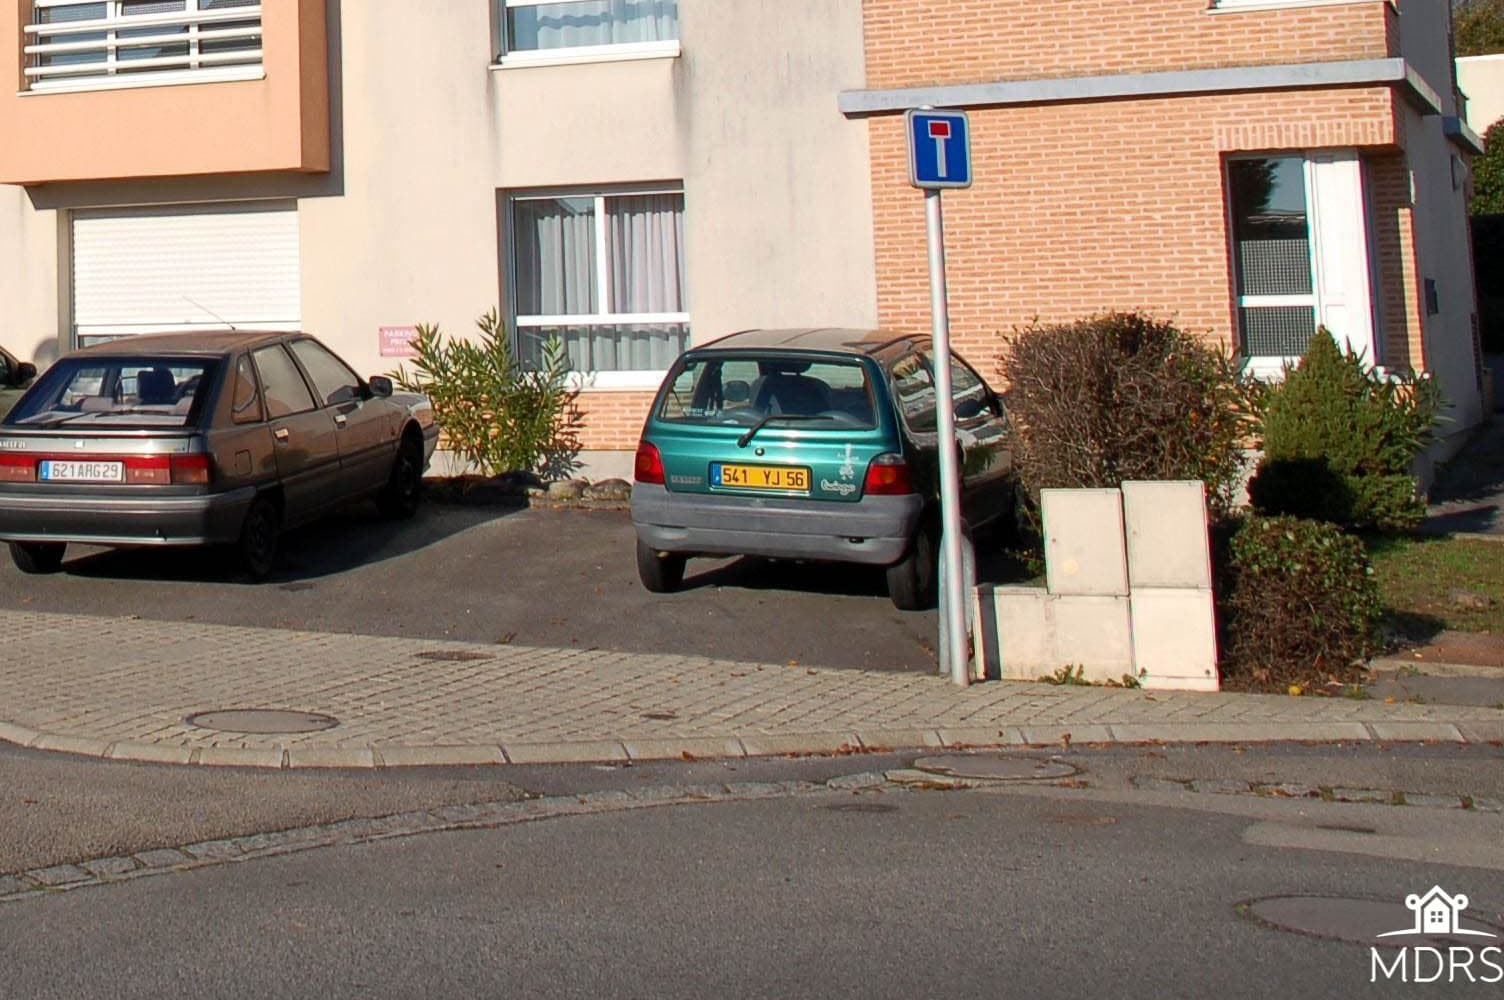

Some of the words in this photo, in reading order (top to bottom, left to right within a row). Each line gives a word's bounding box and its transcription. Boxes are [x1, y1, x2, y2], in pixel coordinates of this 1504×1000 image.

[52, 463, 75, 478] 621
[77, 463, 100, 478] ARG
[102, 464, 118, 479] 29
[723, 467, 749, 483] 541
[763, 469, 781, 486] YJ
[787, 471, 804, 487] 56
